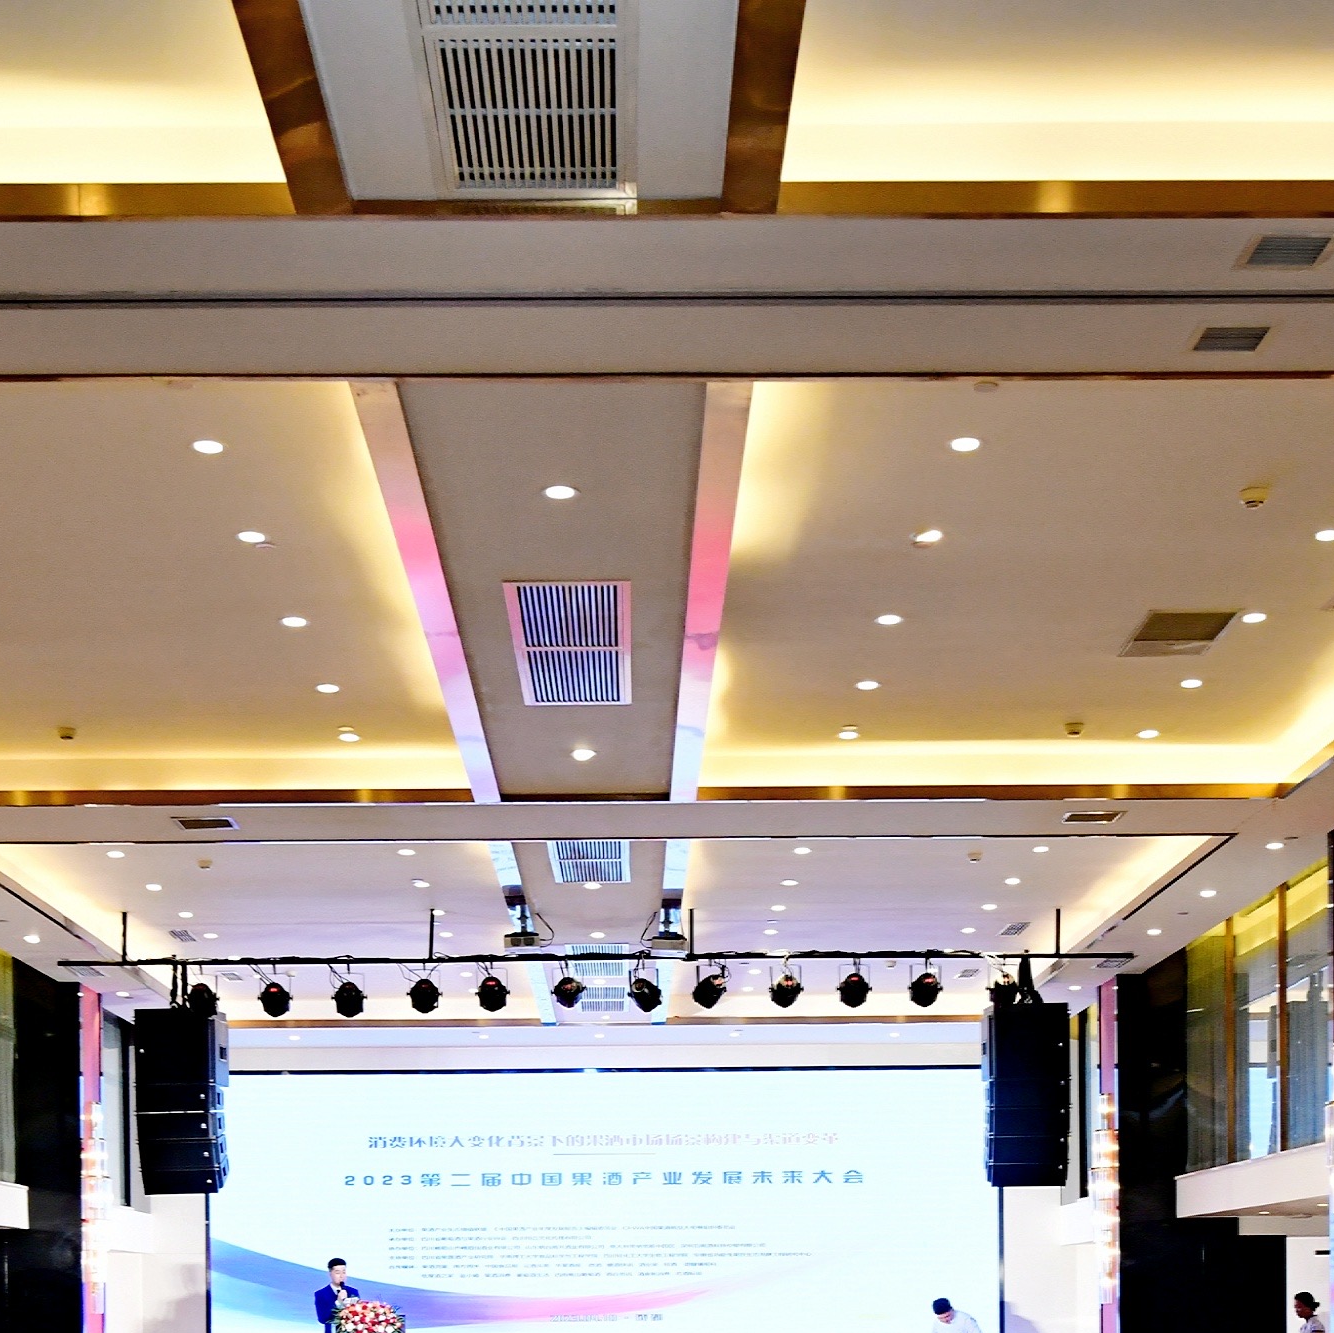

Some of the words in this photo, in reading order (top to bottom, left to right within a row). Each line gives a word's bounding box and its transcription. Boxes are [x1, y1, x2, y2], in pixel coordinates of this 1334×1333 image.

[344, 1169, 863, 1187] 2023第二届中国果酒产业发展未来大会
